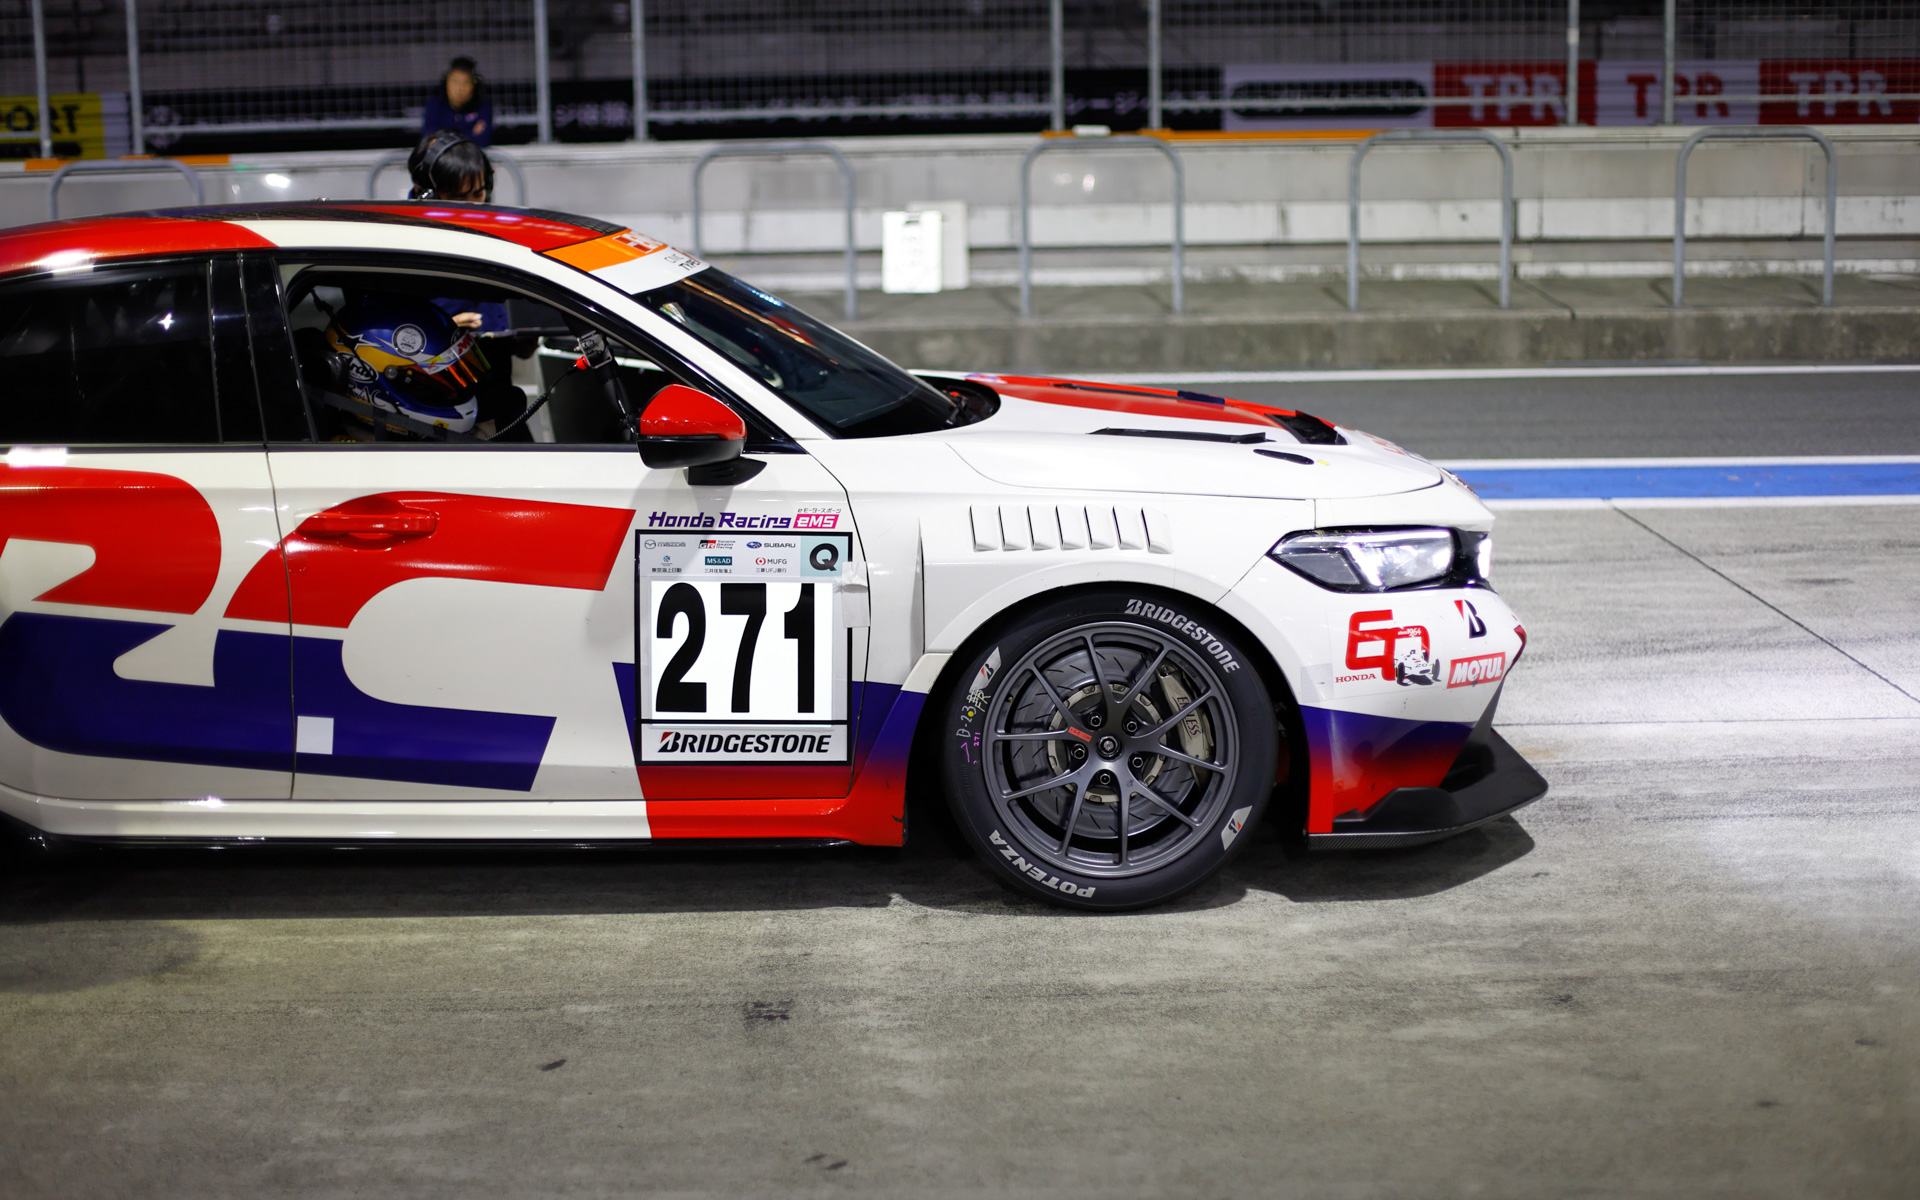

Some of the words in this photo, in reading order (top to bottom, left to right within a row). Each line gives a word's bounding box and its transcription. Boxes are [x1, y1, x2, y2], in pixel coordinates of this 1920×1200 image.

[1461, 72, 1566, 121] TPR
[1788, 70, 1893, 116] TPR
[648, 511, 715, 529] Honda
[719, 511, 792, 529] Racing
[698, 541, 717, 549] GR
[809, 542, 839, 572] Q
[1124, 598, 1241, 674] BRIDGESTONE
[1406, 627, 1421, 636] 1964
[655, 582, 815, 713] 271
[1335, 672, 1377, 684] HONDA
[1450, 655, 1503, 685] MOTUL
[657, 731, 832, 753] BRIDGESTONE
[973, 731, 981, 747] 271
[988, 829, 1097, 899] POTENZA
